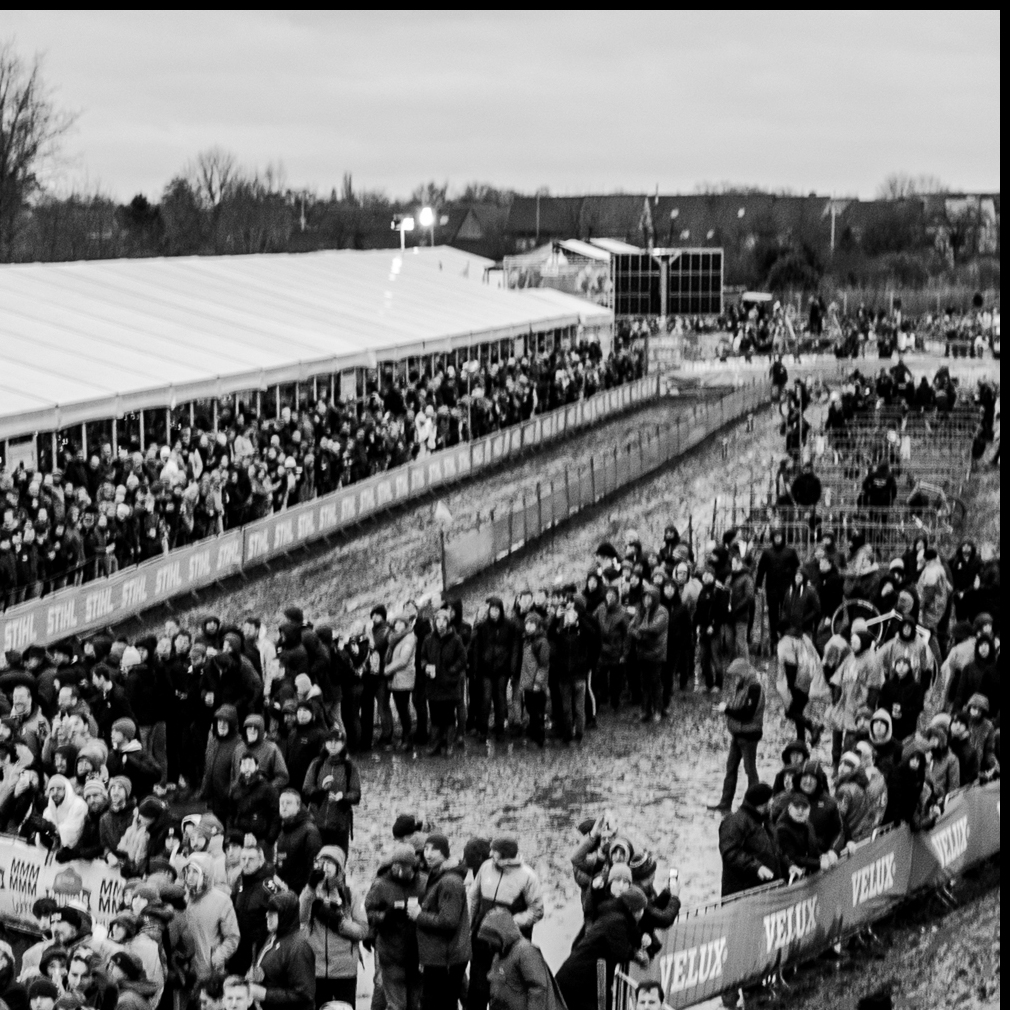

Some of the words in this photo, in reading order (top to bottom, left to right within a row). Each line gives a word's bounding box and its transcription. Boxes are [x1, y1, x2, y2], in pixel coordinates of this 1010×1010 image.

[121, 575, 147, 608] STIHL
[155, 561, 182, 595] STIHL
[47, 599, 77, 635] STIHL
[86, 586, 113, 623] STIHL
[4, 612, 37, 650] STIHL
[931, 814, 968, 869] VELUX
[851, 851, 895, 908] VELUX
[764, 893, 818, 954] VELUX
[660, 936, 727, 999] VELUX
